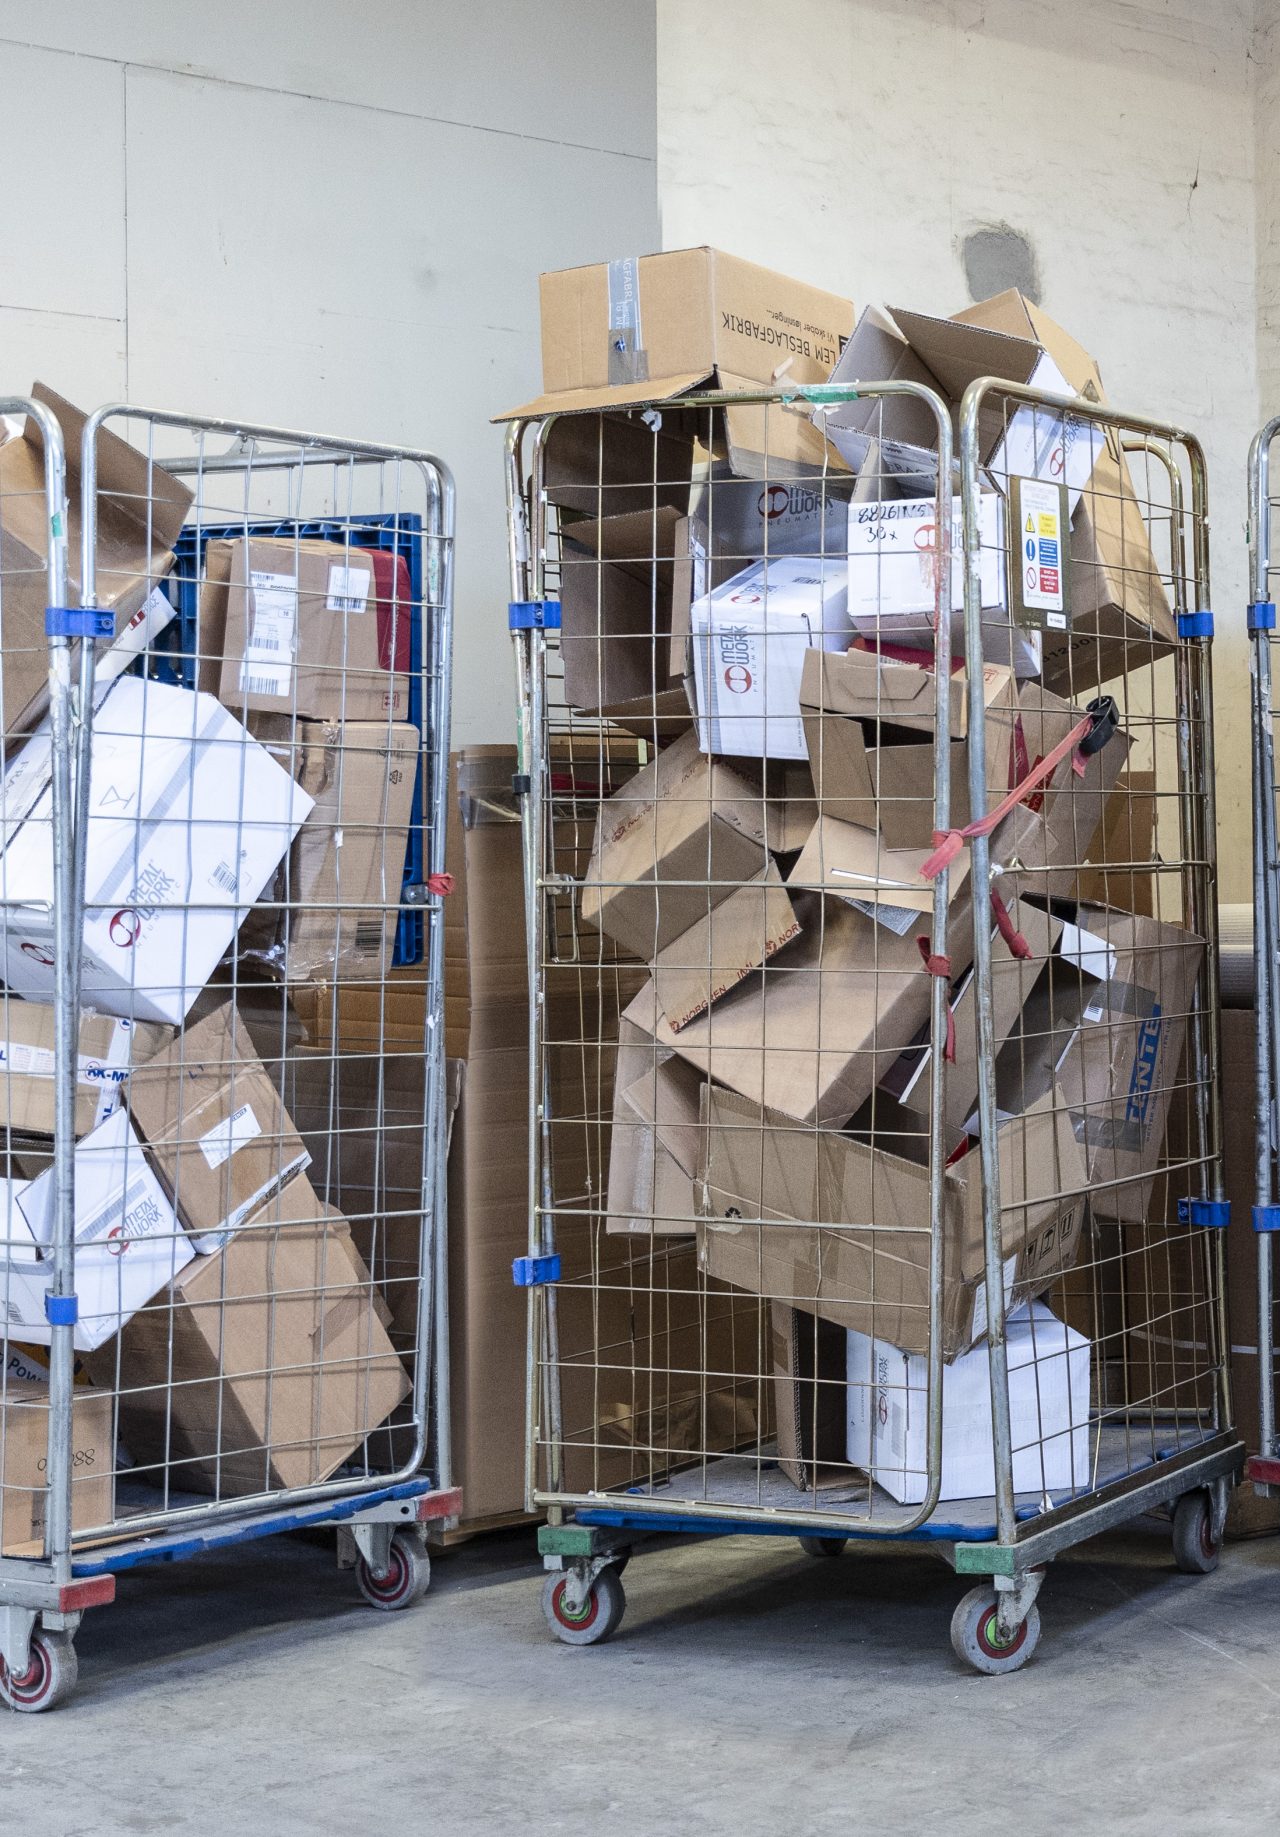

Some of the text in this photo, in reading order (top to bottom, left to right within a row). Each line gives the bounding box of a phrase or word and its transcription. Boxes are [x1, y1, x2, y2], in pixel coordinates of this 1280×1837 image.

[721, 310, 810, 357] BESLAGFABRIK
[803, 323, 826, 339] skaber
[758, 510, 835, 527] PNEUMATC
[789, 496, 834, 515] WORK
[720, 624, 735, 665] METAL
[734, 625, 750, 666] WORK
[748, 626, 759, 694] PNEUMATC
[126, 862, 162, 905] METAL
[136, 872, 175, 922] WORK
[125, 1196, 157, 1231] METAL
